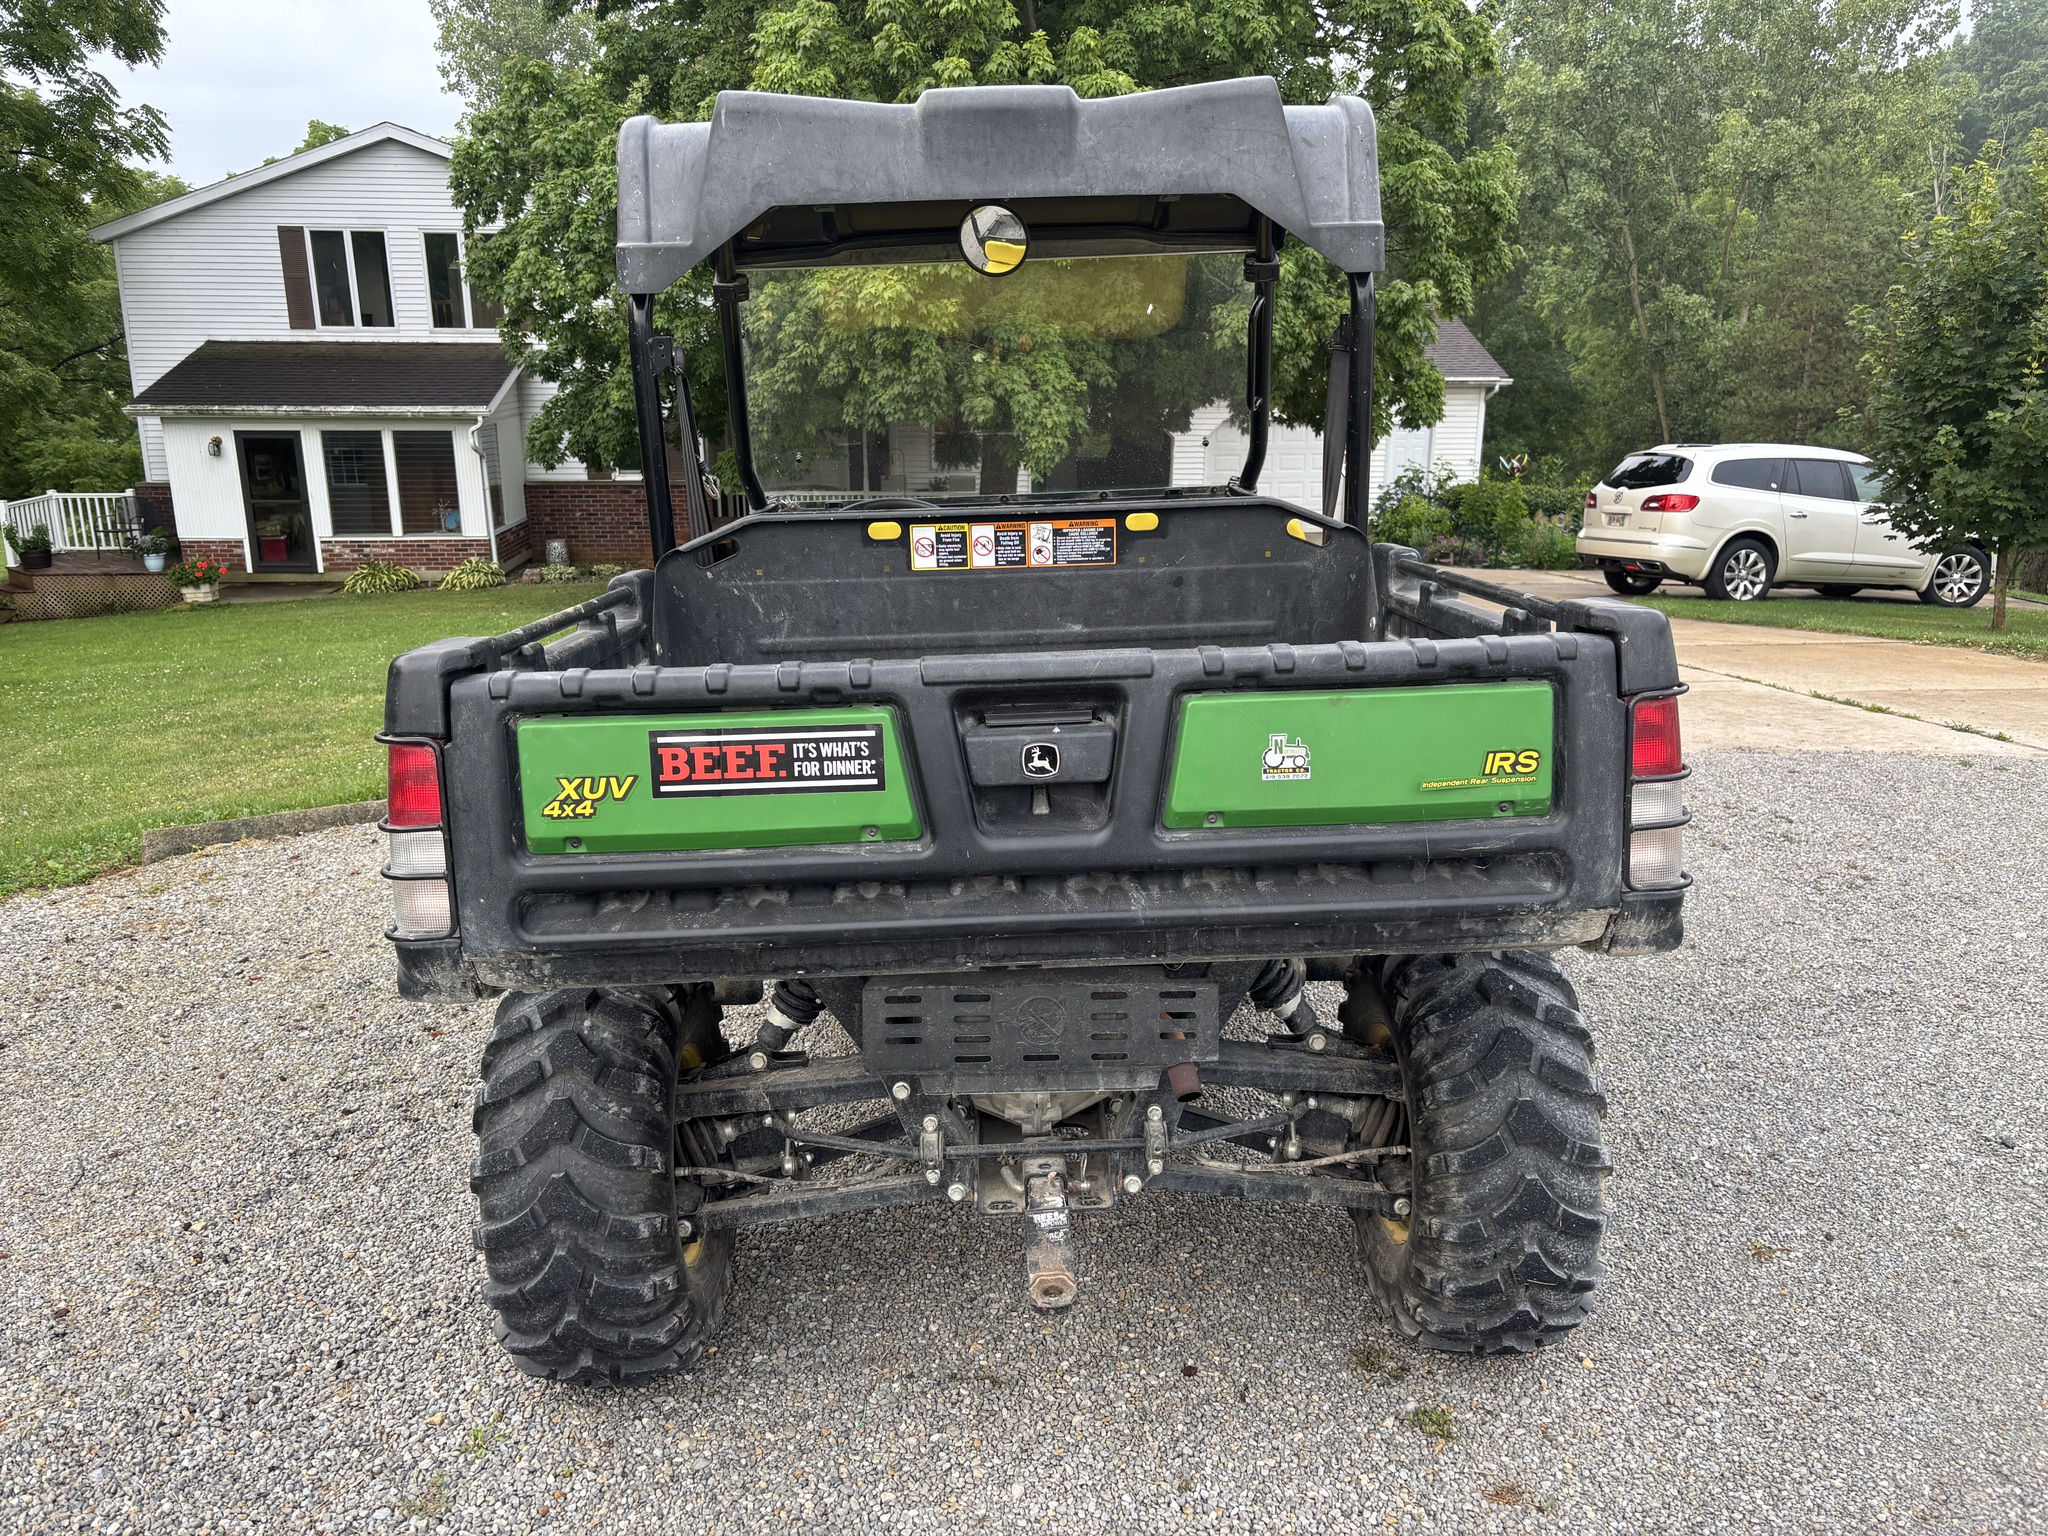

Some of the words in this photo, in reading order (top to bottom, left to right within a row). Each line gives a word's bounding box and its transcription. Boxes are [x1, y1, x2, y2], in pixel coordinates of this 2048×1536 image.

[793, 743, 817, 758] IT'S
[819, 741, 869, 757] WHAT'S
[657, 744, 787, 781] BEEF.
[794, 762, 820, 777] FOR
[1484, 750, 1540, 775] IRS
[555, 776, 637, 801] XUV
[1422, 779, 1469, 789] Independent
[1491, 775, 1537, 784] Suspension
[543, 800, 595, 818] 4x4
